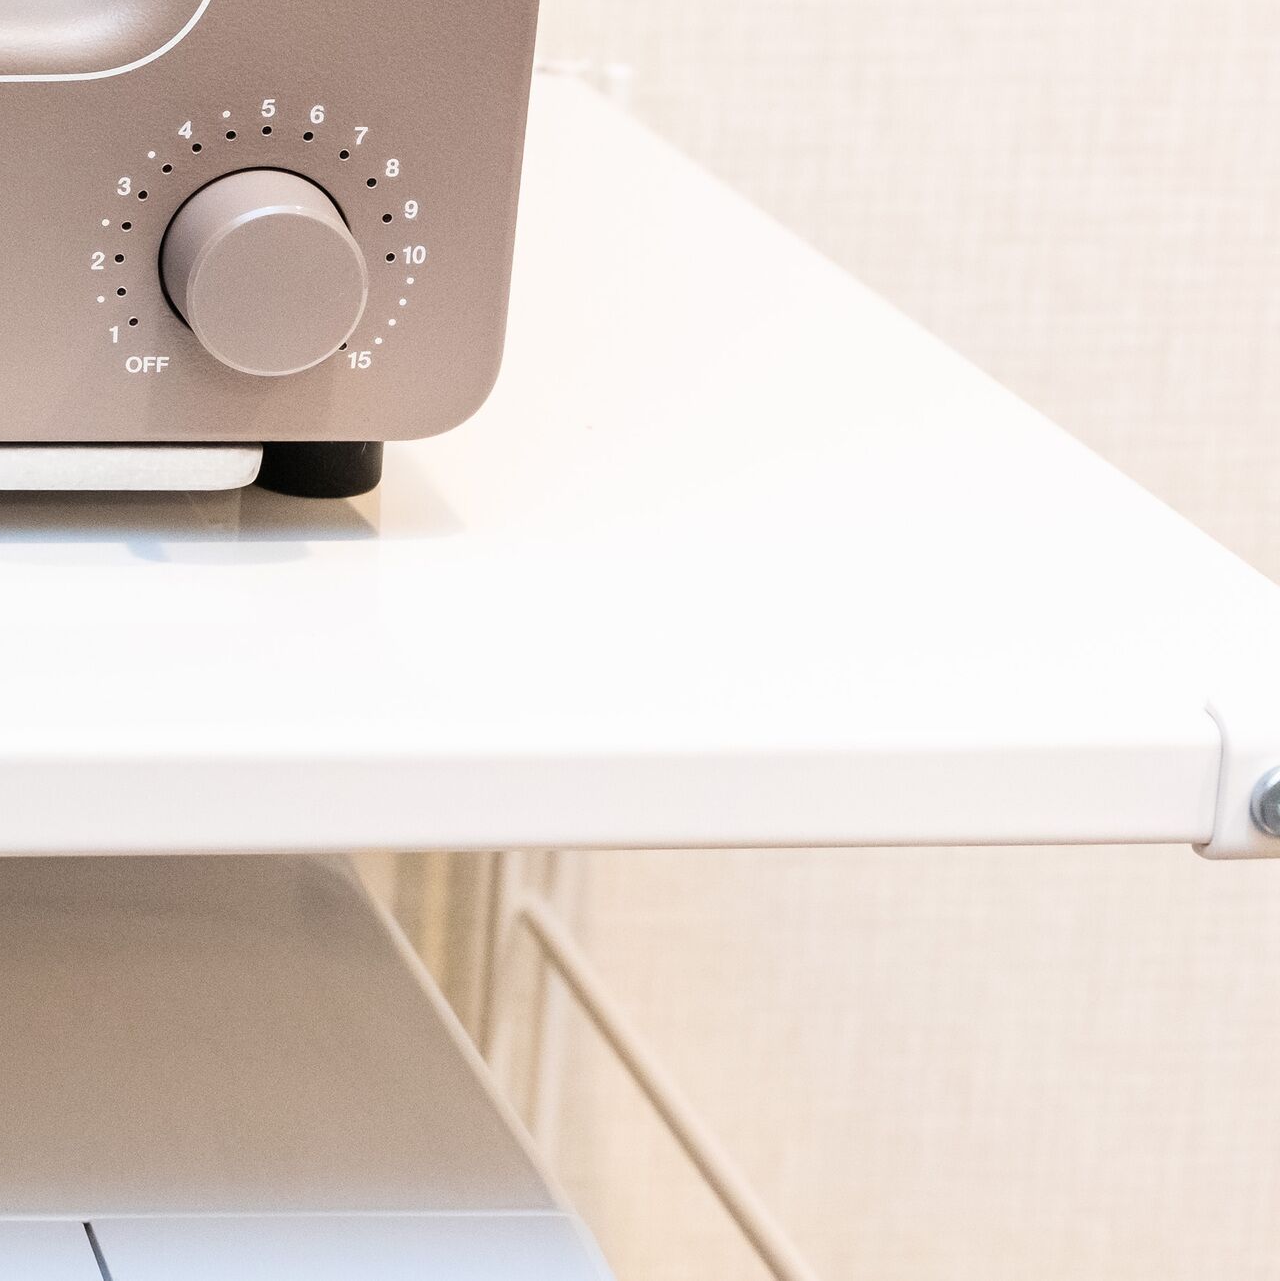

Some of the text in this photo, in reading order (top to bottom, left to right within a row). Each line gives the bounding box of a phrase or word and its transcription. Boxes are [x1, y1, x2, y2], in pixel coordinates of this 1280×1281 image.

[261, 99, 276, 117] 5
[310, 105, 325, 124] 6
[178, 121, 192, 139] 4
[355, 127, 369, 145] 7
[385, 159, 400, 177] 8
[117, 177, 131, 195] 3
[404, 200, 419, 219] 9
[91, 252, 105, 270] 2
[403, 246, 427, 264] 10
[109, 326, 119, 344] 1
[126, 356, 169, 373] OFF
[347, 351, 372, 369] 15
